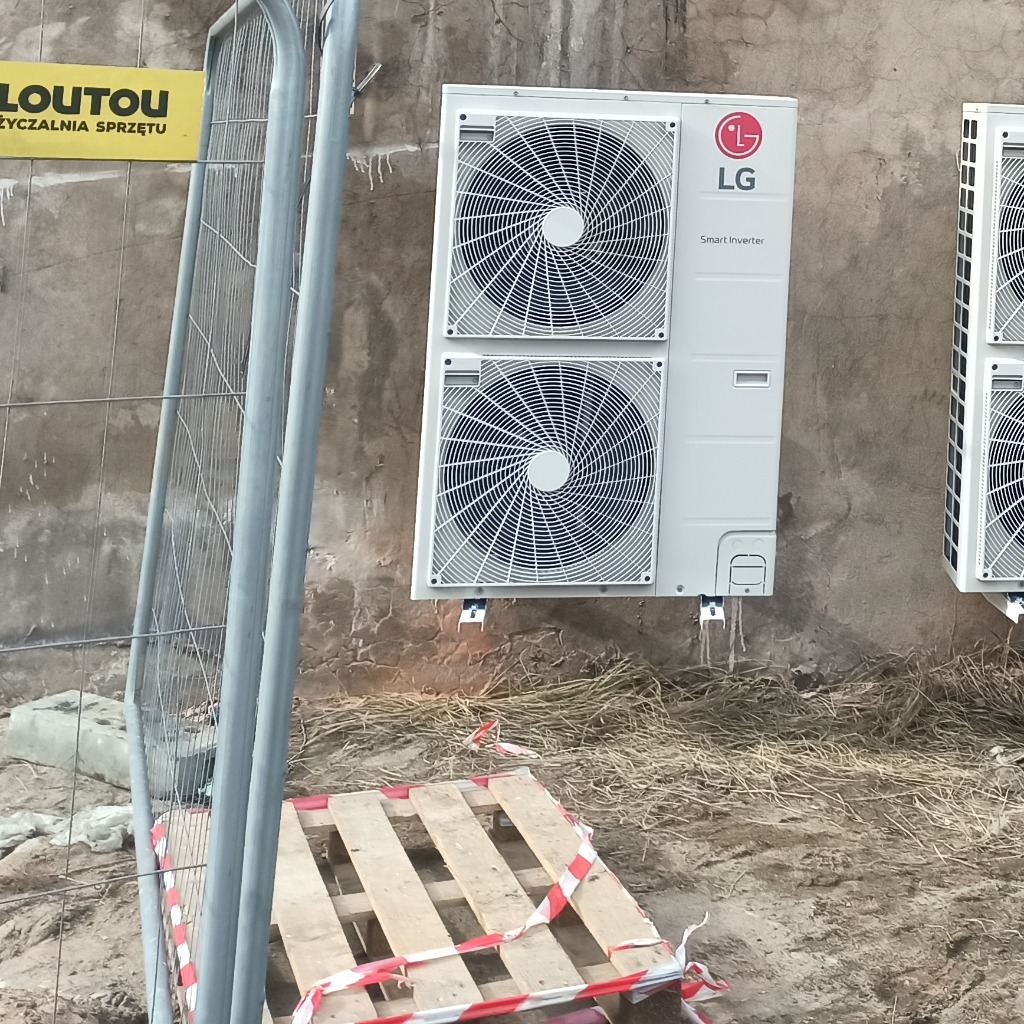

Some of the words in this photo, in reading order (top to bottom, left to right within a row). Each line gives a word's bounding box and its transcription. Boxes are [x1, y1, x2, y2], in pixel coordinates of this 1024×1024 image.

[0, 83, 169, 118] LOUTOU
[96, 121, 167, 136] SPRZĘTU
[718, 167, 756, 191] LG
[700, 235, 727, 244] Smart
[729, 236, 765, 245] Inverter
